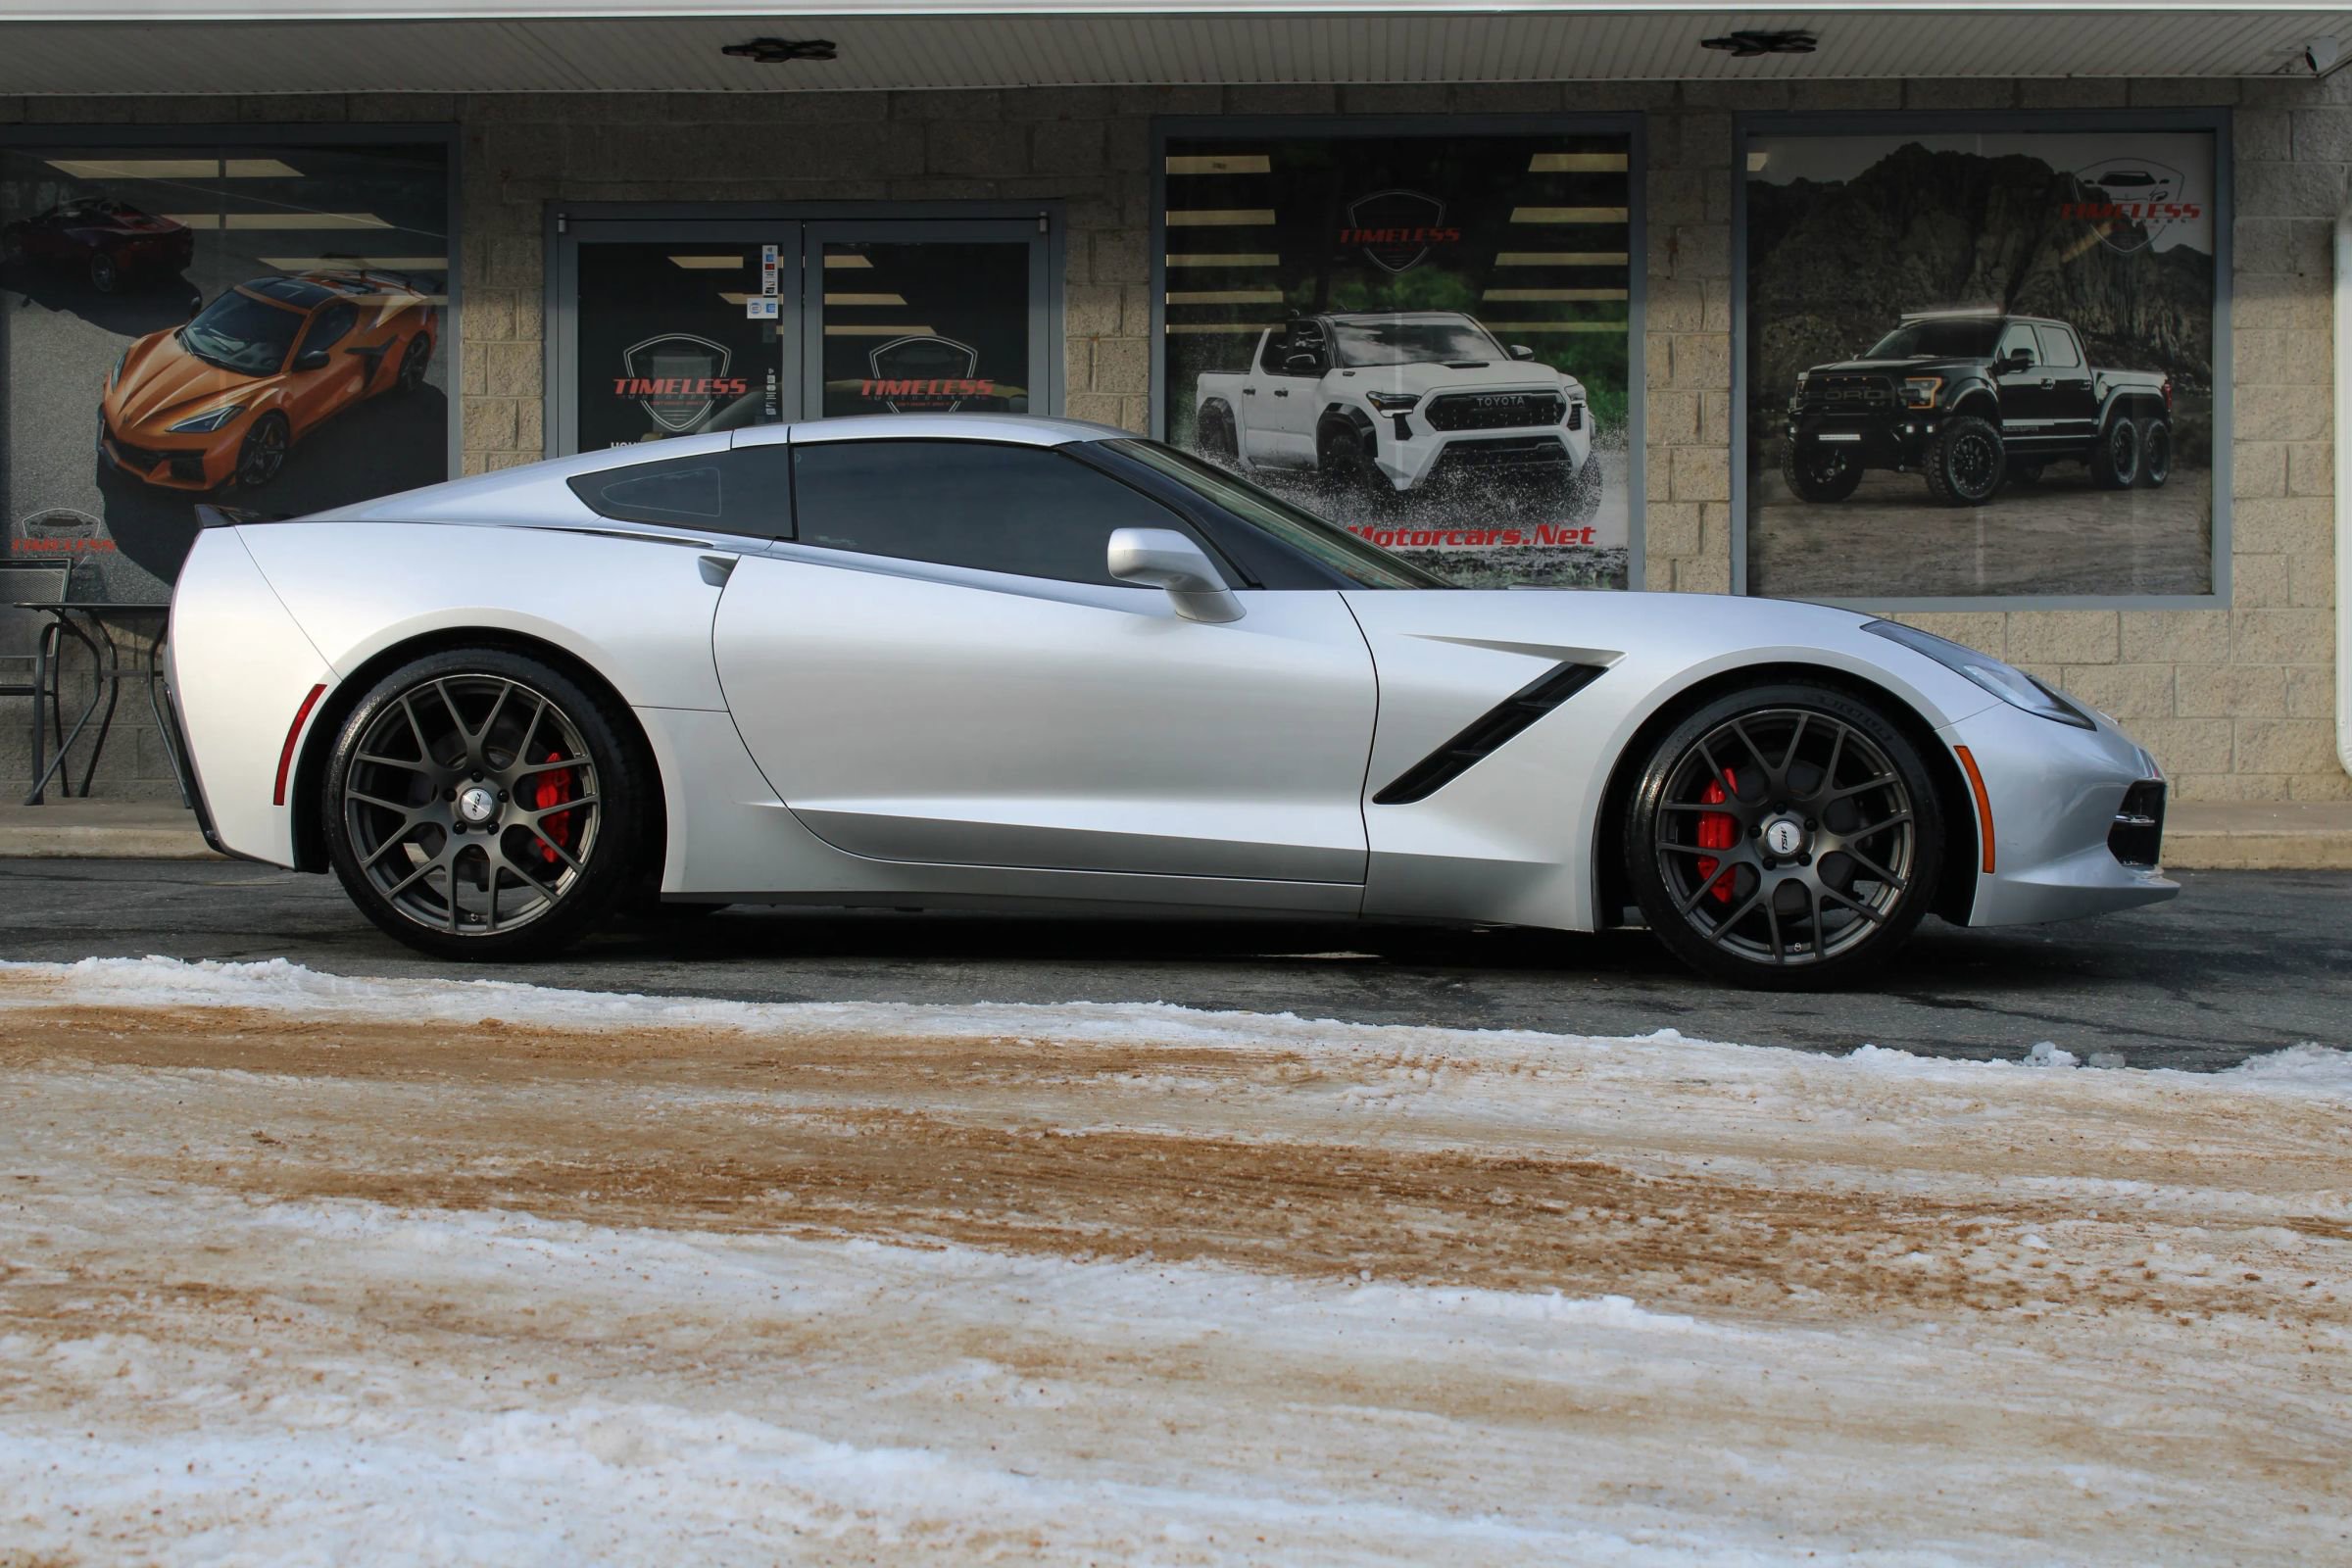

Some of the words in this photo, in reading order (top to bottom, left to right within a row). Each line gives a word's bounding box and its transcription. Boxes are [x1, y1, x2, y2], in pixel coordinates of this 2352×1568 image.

[2060, 203, 2201, 220] TIMELESS
[1339, 227, 1460, 244] TIMELESS
[612, 378, 749, 395] TIMELESS
[860, 378, 996, 396] TIMELESS
[1476, 396, 1526, 408] TOYOTA
